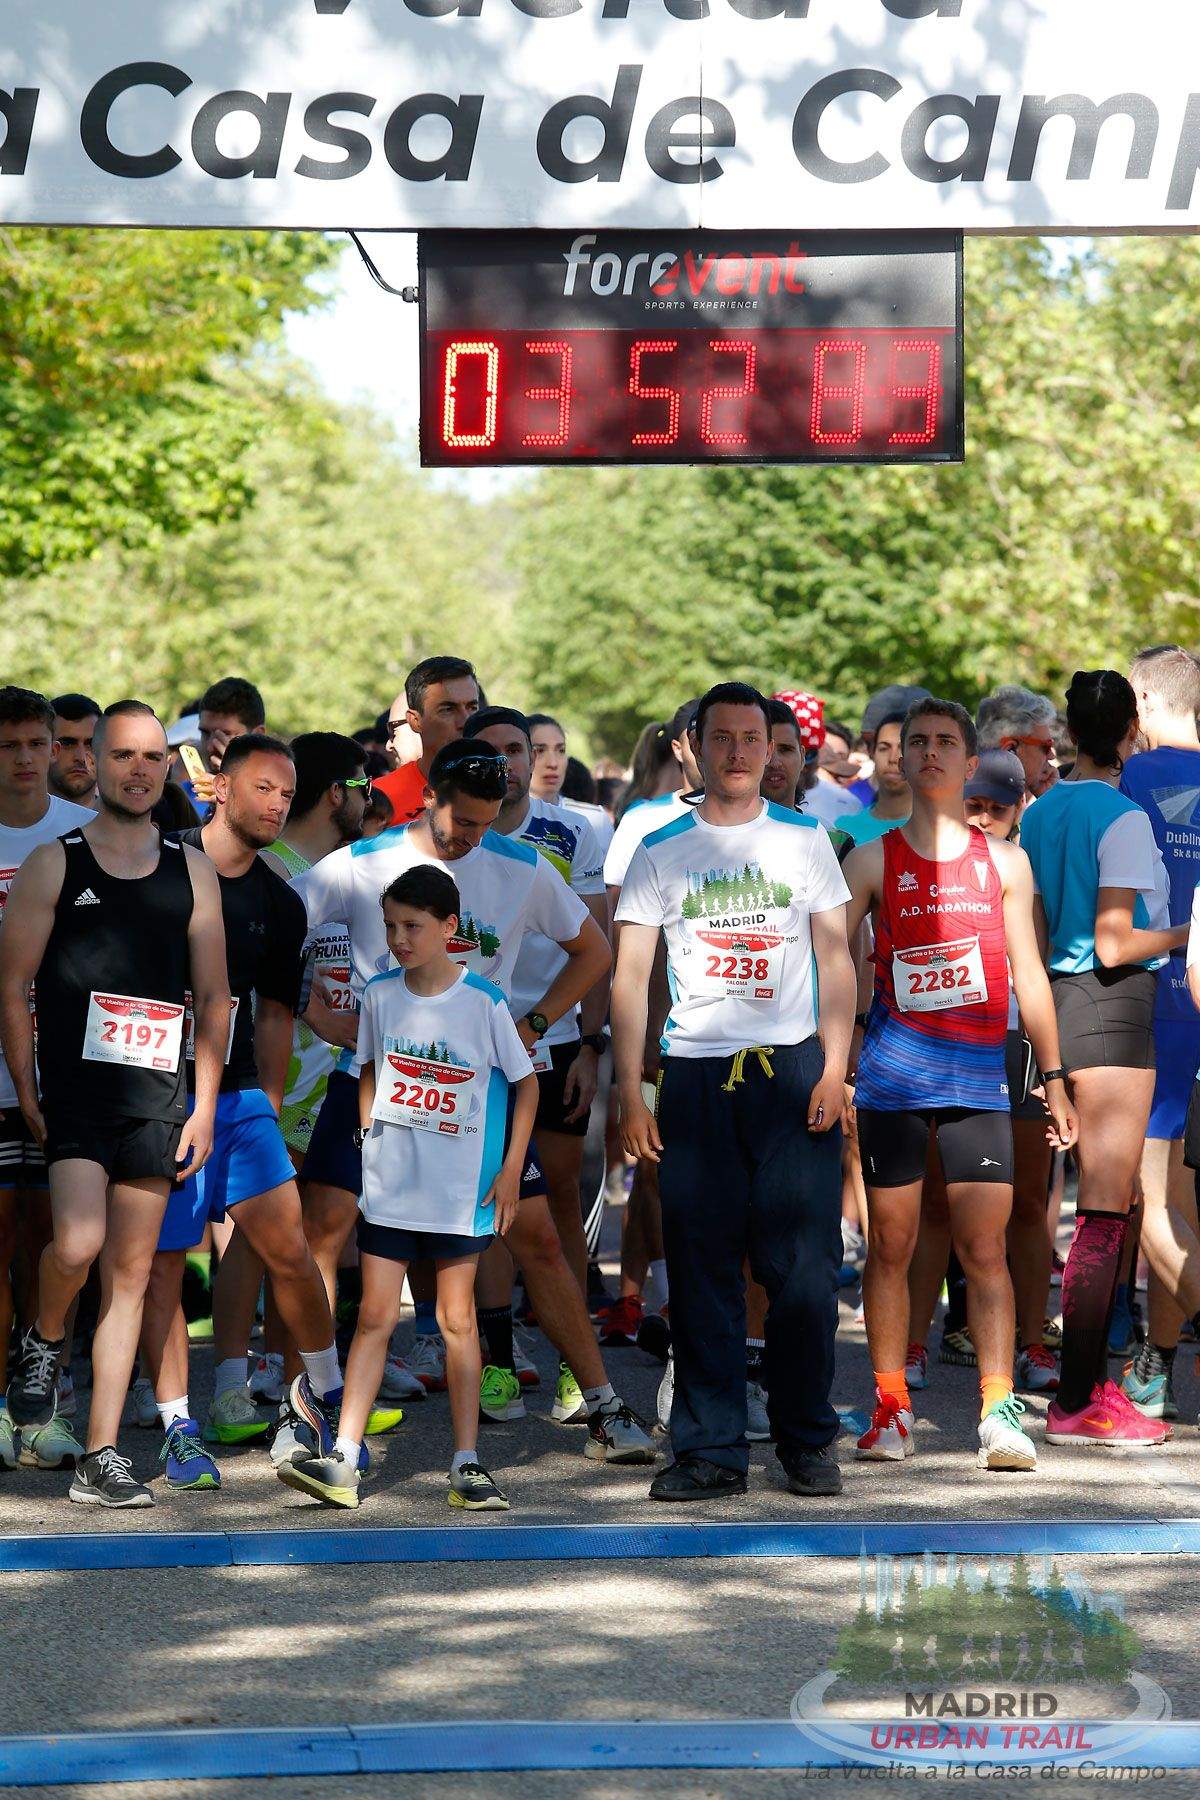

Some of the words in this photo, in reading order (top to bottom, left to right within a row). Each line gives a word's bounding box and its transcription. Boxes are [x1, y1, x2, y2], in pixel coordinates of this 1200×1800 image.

[80, 61, 485, 182] Casa
[536, 64, 737, 184] de
[562, 234, 807, 298] forevent
[644, 300, 686, 310] SPORTS
[692, 300, 759, 310] EXPERIENCE
[443, 341, 573, 447] 03
[629, 340, 757, 445] 52
[74, 898, 101, 906] adidas
[900, 906, 924, 918] A.D.
[926, 901, 993, 915] MARATHON
[708, 913, 767, 929] MADRID
[705, 955, 769, 981] 2238
[907, 965, 972, 995] 2282
[99, 1021, 168, 1049] 2197
[450, 1070, 471, 1078] Campo
[389, 1081, 458, 1115] 2205
[412, 1109, 430, 1117] DAVID
